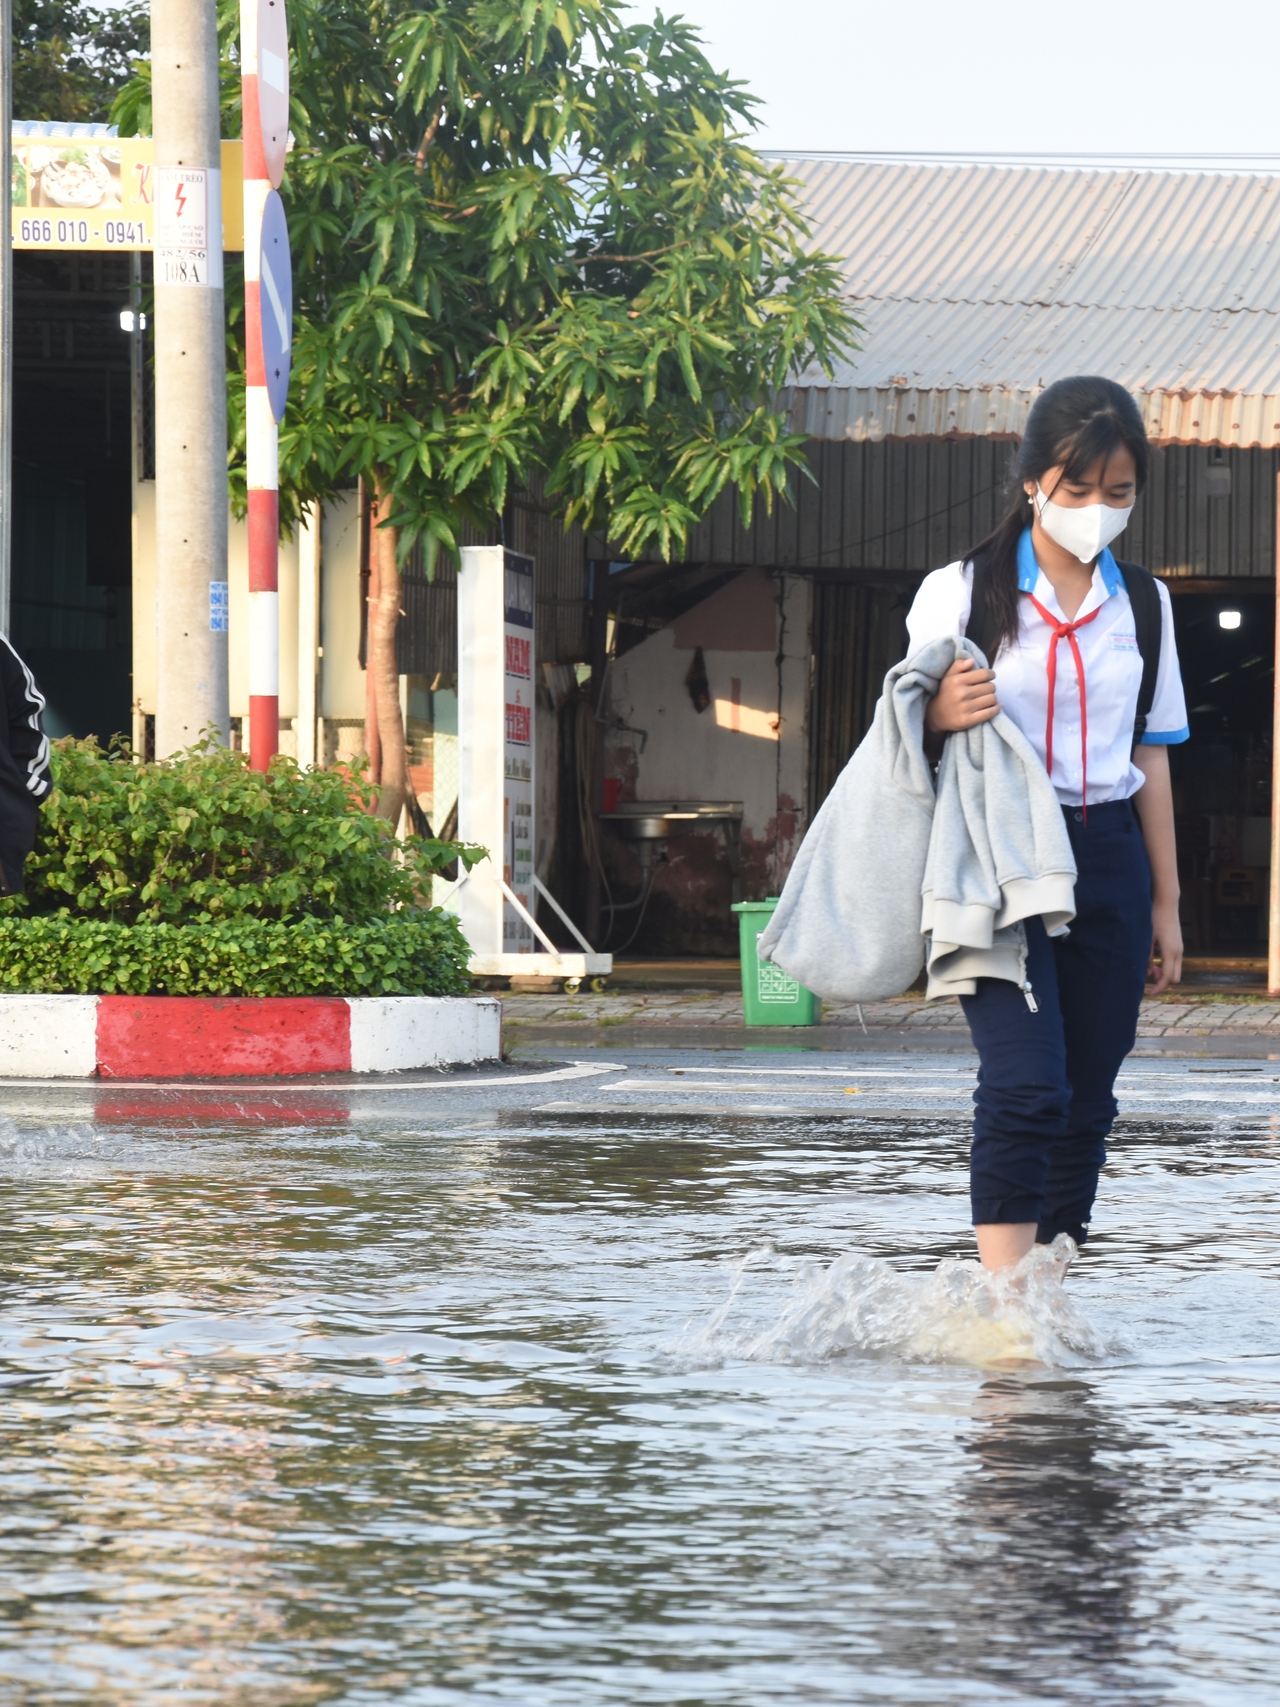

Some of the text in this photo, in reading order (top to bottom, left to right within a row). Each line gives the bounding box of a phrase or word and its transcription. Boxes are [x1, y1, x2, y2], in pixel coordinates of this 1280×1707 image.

[132, 163, 154, 204] K
[21, 220, 51, 241] 666
[58, 220, 87, 242] 010
[160, 248, 206, 259] 482/56
[165, 260, 200, 283] 108A
[505, 635, 531, 675] NAM
